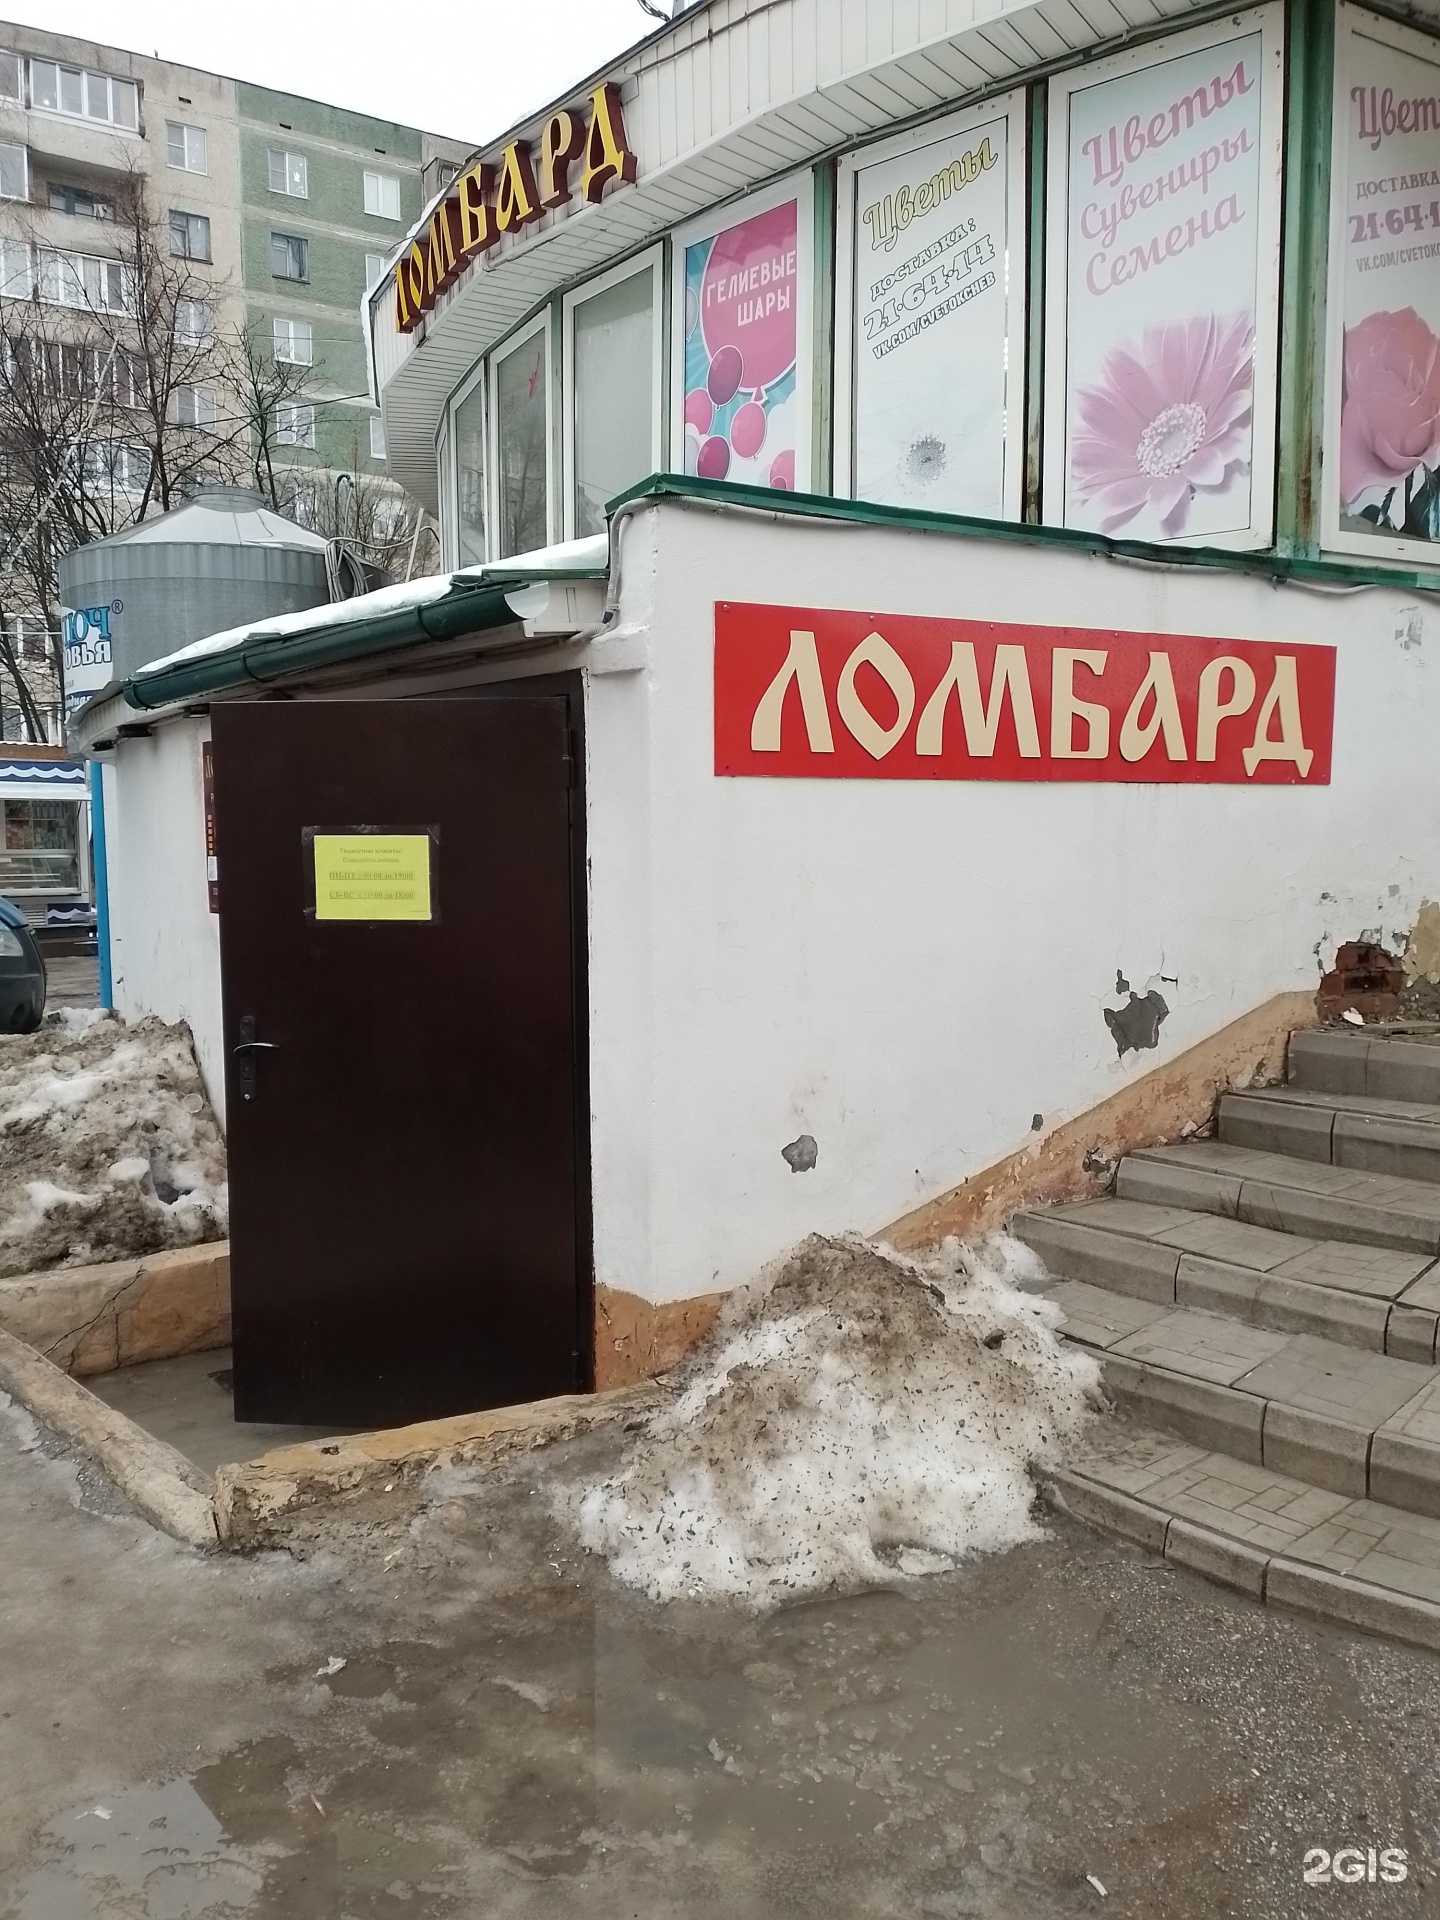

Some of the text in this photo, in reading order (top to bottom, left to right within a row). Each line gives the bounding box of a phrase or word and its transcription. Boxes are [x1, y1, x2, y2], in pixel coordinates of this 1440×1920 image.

[1082, 60, 1255, 187] Цветы
[1351, 86, 1440, 151] Цвет
[395, 82, 637, 333] ЛОМБАРД
[863, 137, 998, 252] Цветы
[1080, 127, 1254, 248] Сувениры
[1086, 192, 1246, 296] Семена
[706, 250, 796, 308] ГЕЛИЕВЫЕ
[737, 285, 790, 327] ШАРЫ
[751, 630, 1314, 778] ЛОМБАРД
